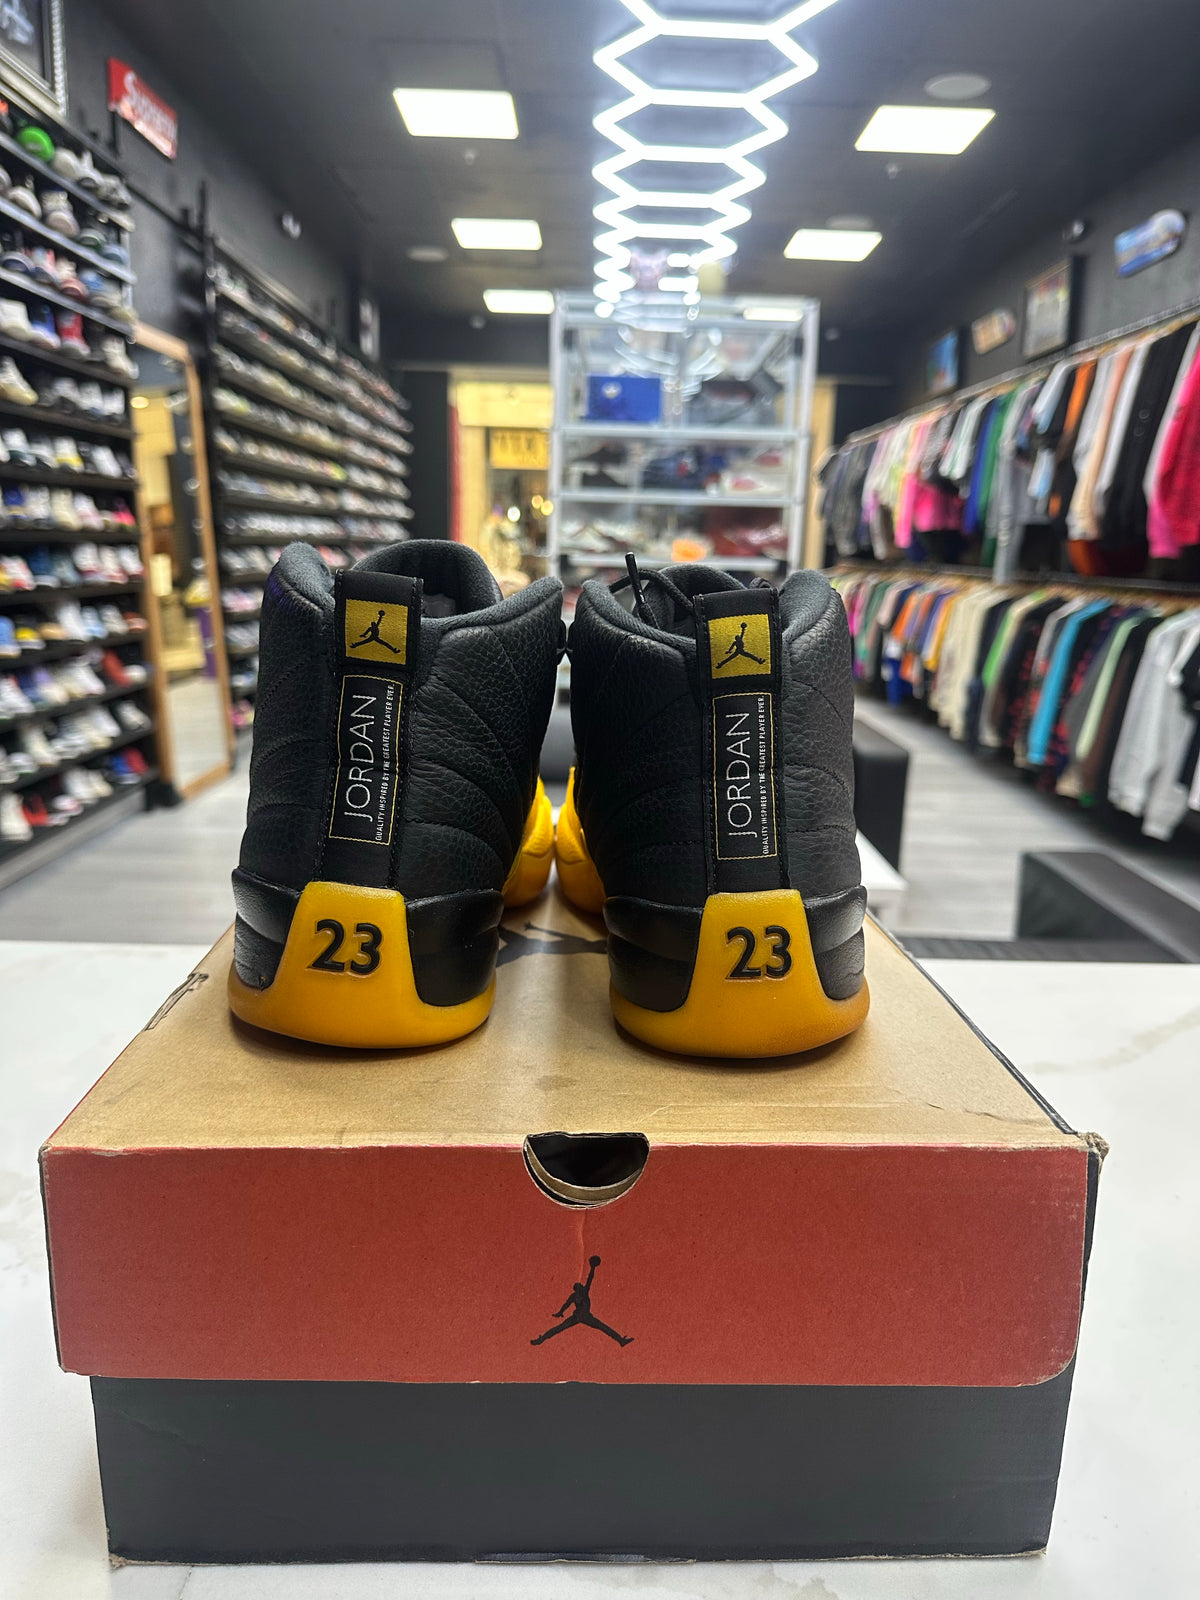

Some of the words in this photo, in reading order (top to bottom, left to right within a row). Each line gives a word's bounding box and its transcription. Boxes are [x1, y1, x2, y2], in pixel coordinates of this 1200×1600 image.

[384, 702, 393, 726] PLAYER
[344, 694, 377, 822] JORDAN
[382, 773, 389, 781] BY
[725, 713, 758, 837] JORDAN
[379, 783, 389, 811] INSPIRED
[760, 786, 766, 794] BY
[375, 812, 384, 840] QUALITY
[761, 826, 769, 854] QUALITY
[311, 918, 382, 975] 23
[727, 925, 792, 977] 23
